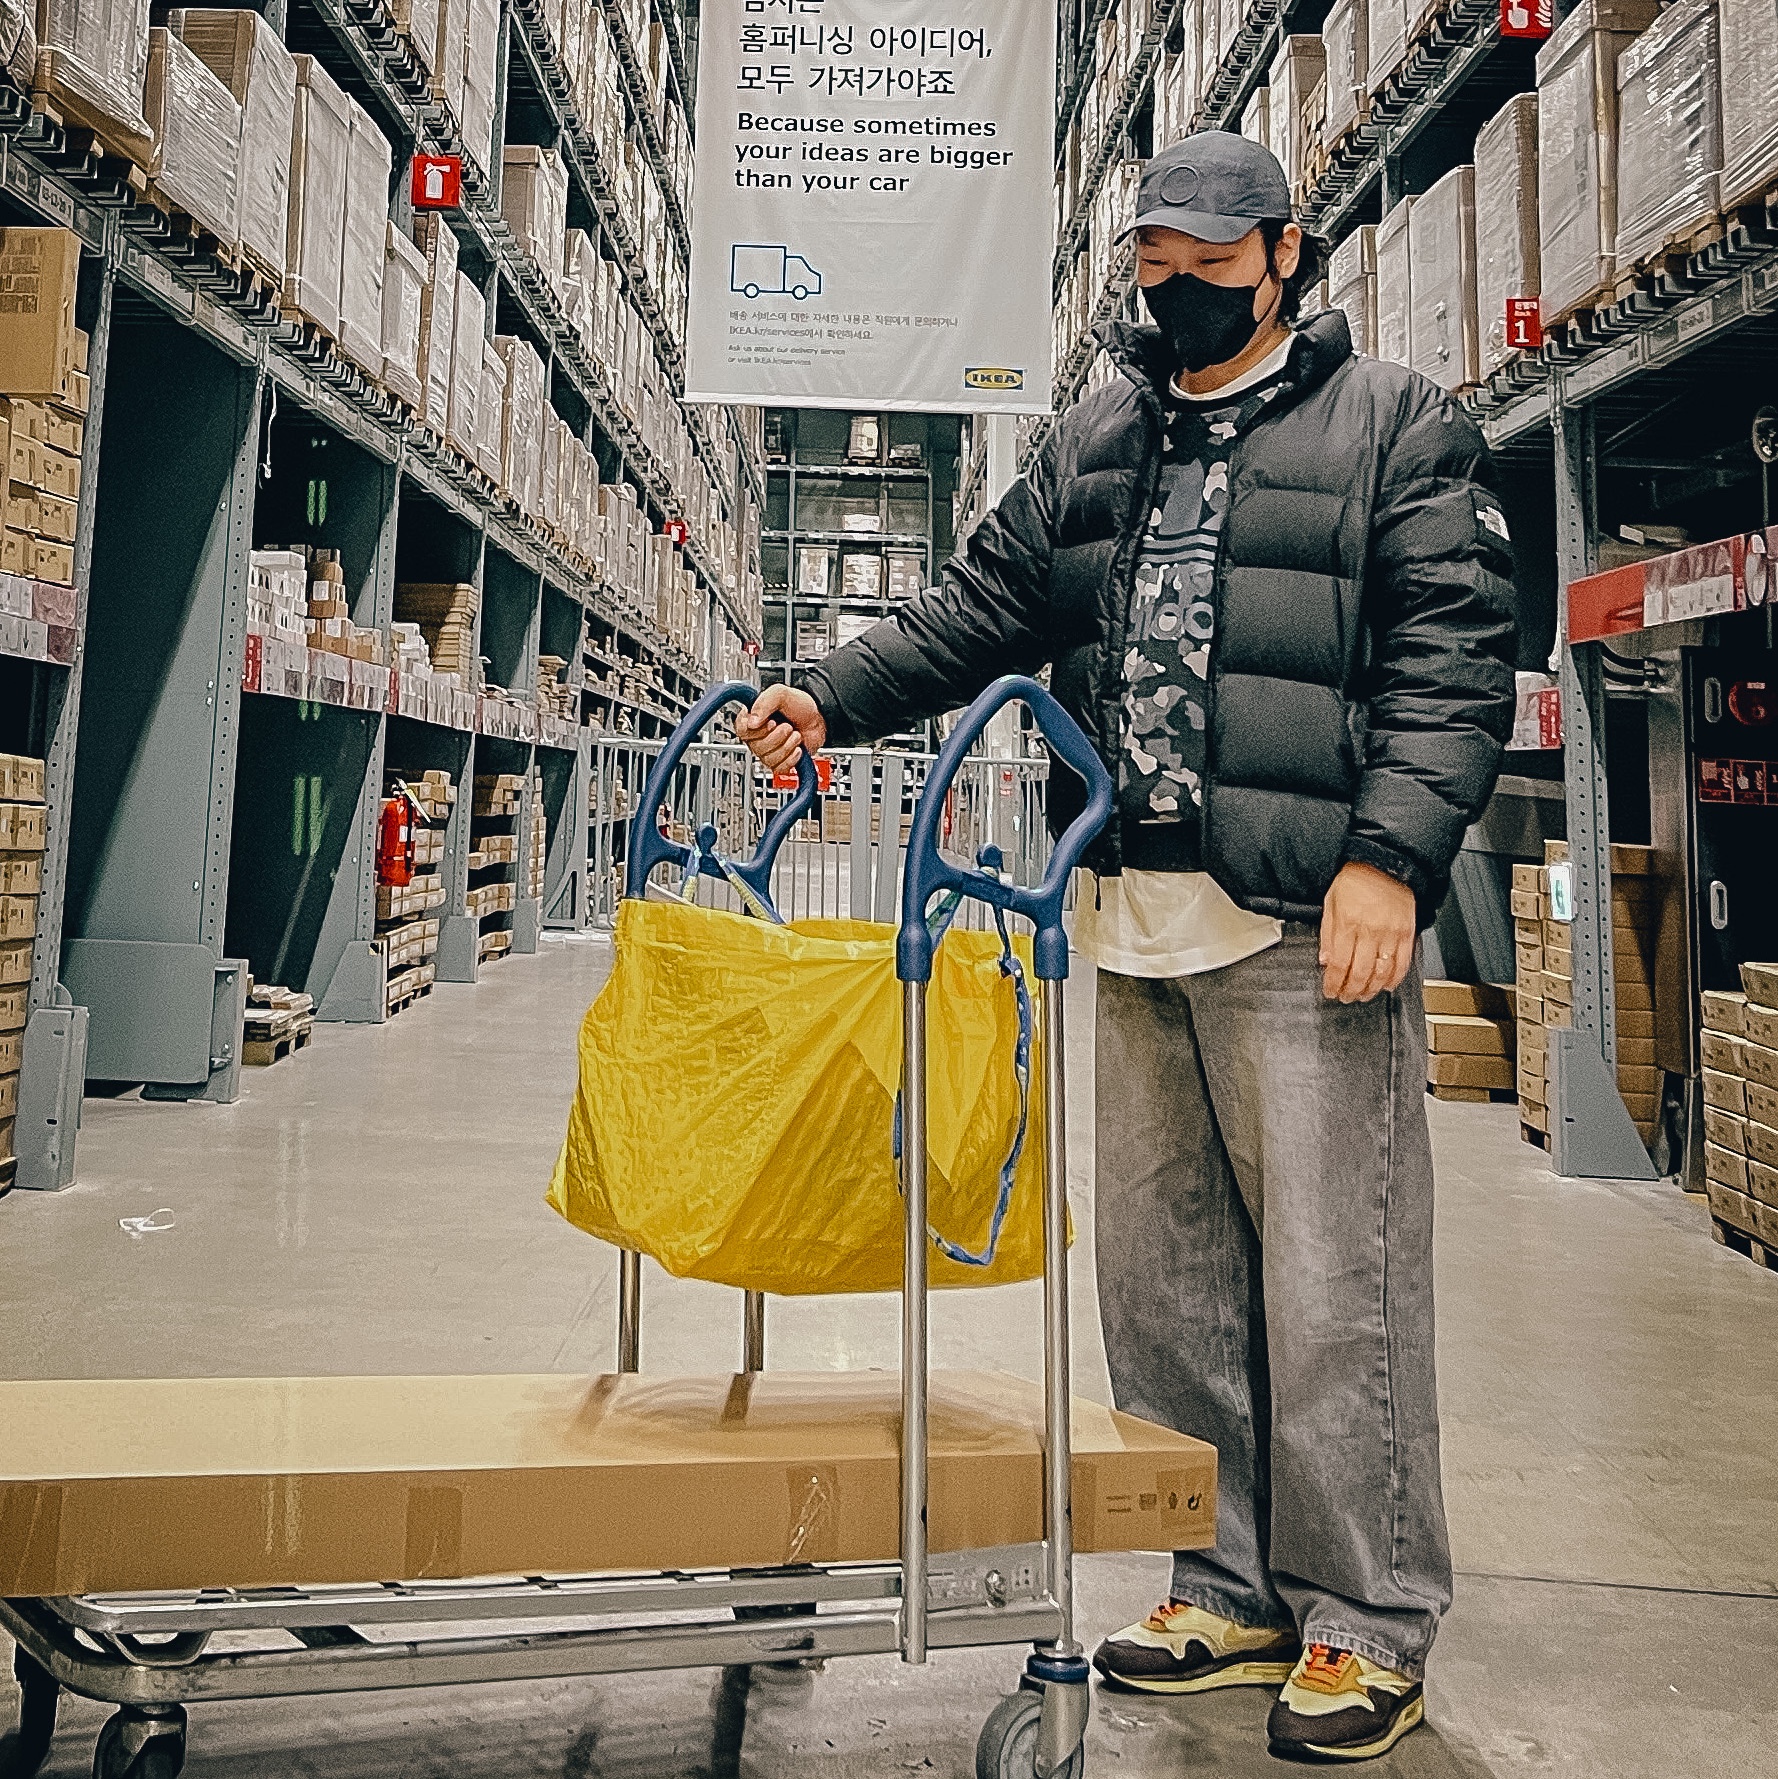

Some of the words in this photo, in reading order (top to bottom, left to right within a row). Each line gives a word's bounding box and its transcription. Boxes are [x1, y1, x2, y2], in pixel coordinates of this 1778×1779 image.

[740, 23, 852, 55] 홈퍼니싱
[870, 26, 992, 58] 아이디어,
[737, 65, 795, 94] 모두
[808, 66, 956, 97] 가져가야죠
[738, 113, 844, 132] Because
[853, 117, 996, 136] sometimes
[735, 144, 792, 163] your
[801, 142, 868, 162] ideas
[878, 149, 920, 163] are
[930, 145, 1014, 169] bigger
[735, 169, 792, 188] than
[802, 174, 860, 193] your
[869, 176, 910, 191] car
[1514, 319, 1530, 343] 1
